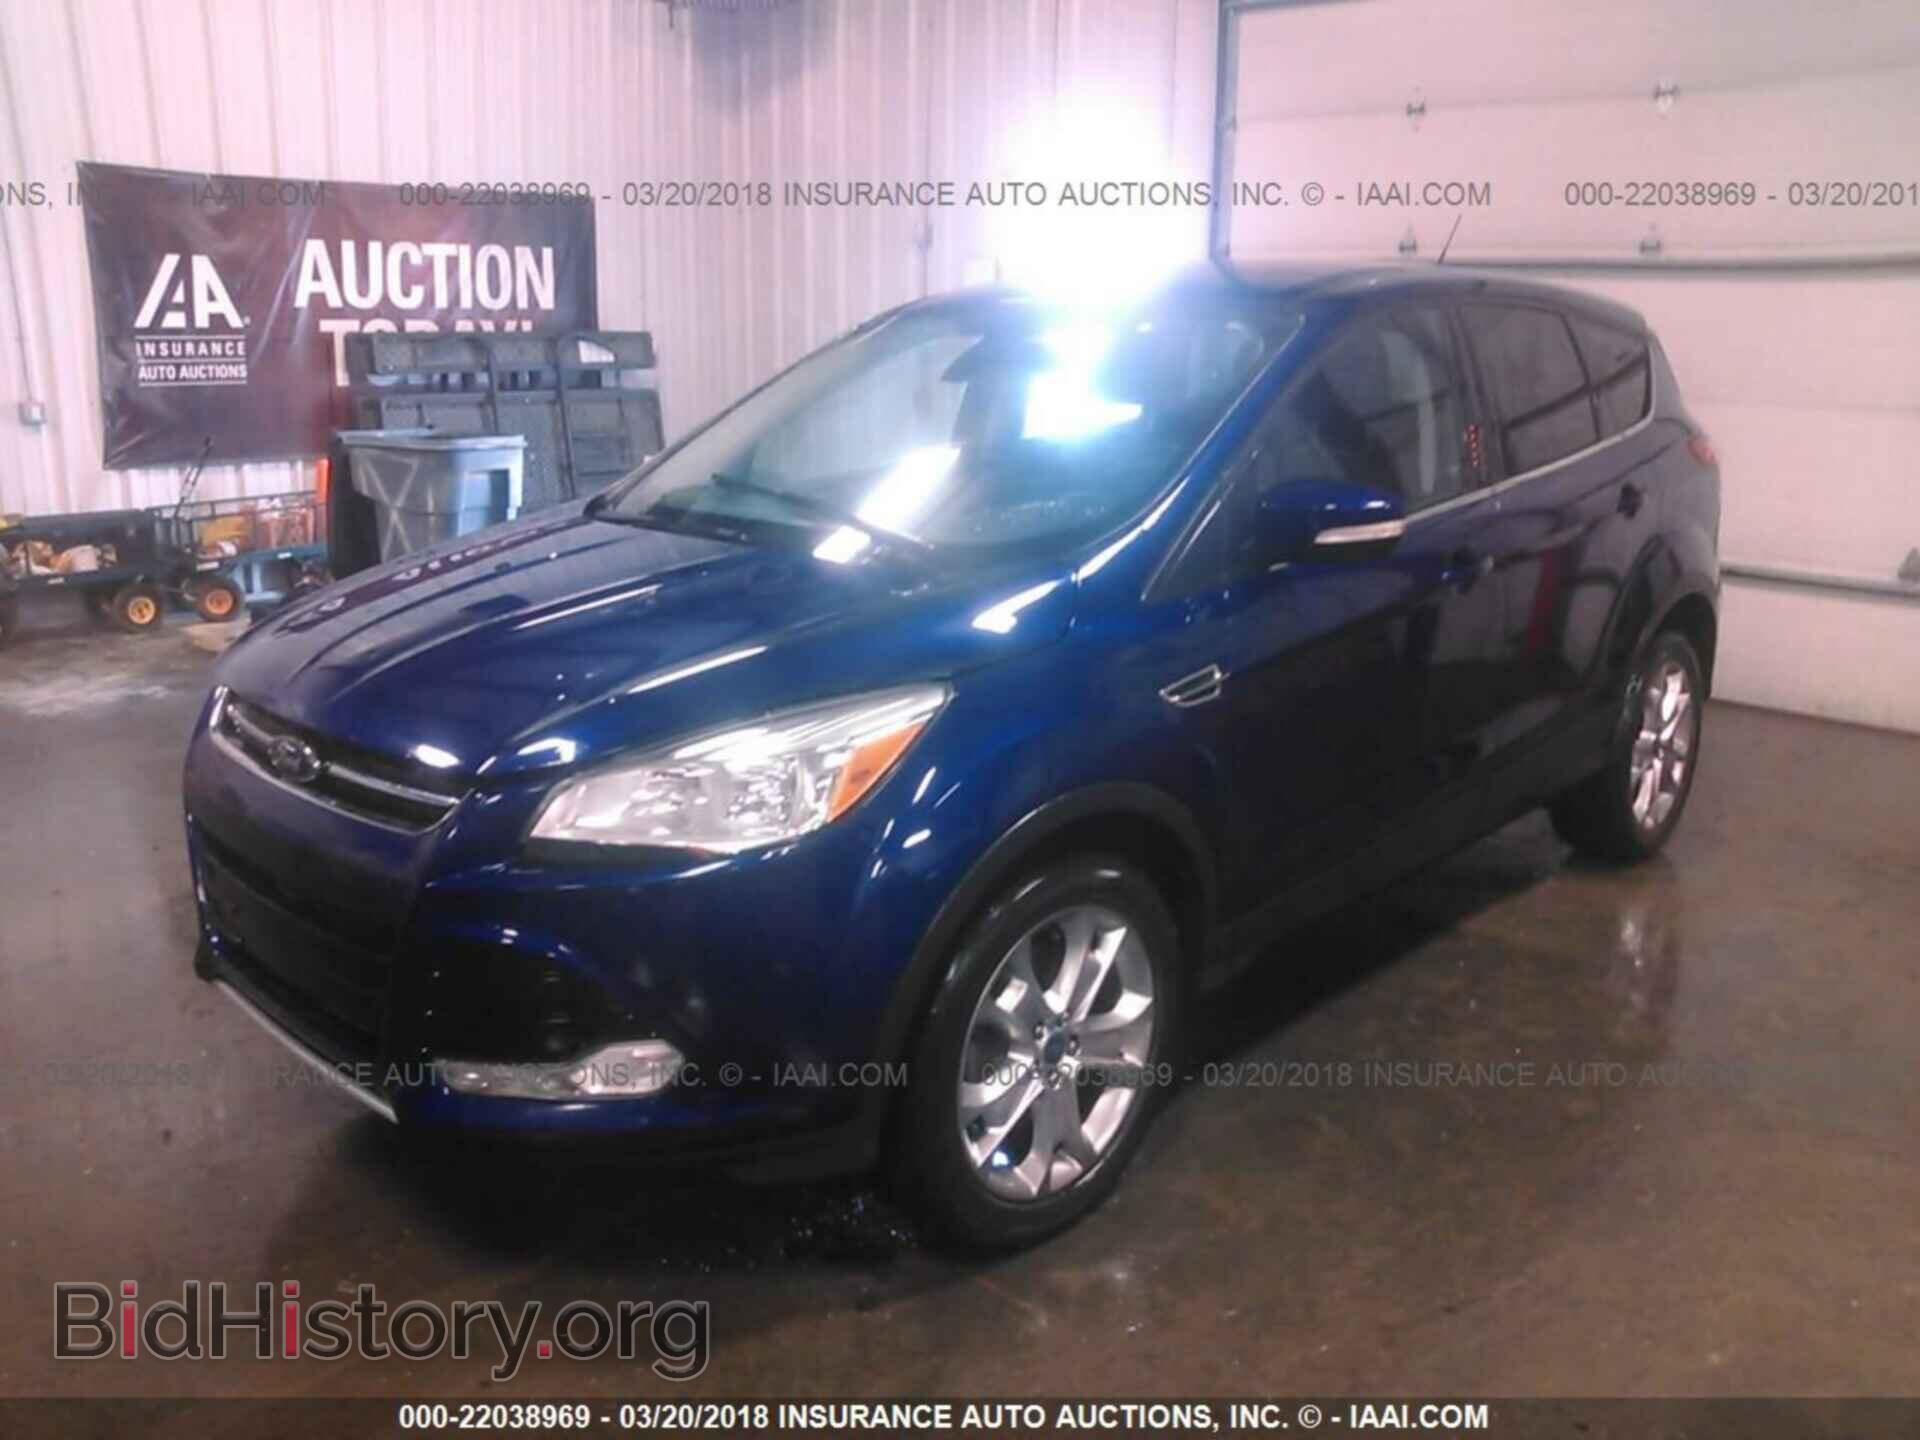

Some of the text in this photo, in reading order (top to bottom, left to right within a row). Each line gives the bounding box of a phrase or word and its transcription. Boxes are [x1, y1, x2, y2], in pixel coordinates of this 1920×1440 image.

[294, 239, 555, 310] AUCTION
[136, 341, 246, 357] INSURANCE
[138, 363, 247, 380] AUTO AUCTIONS
